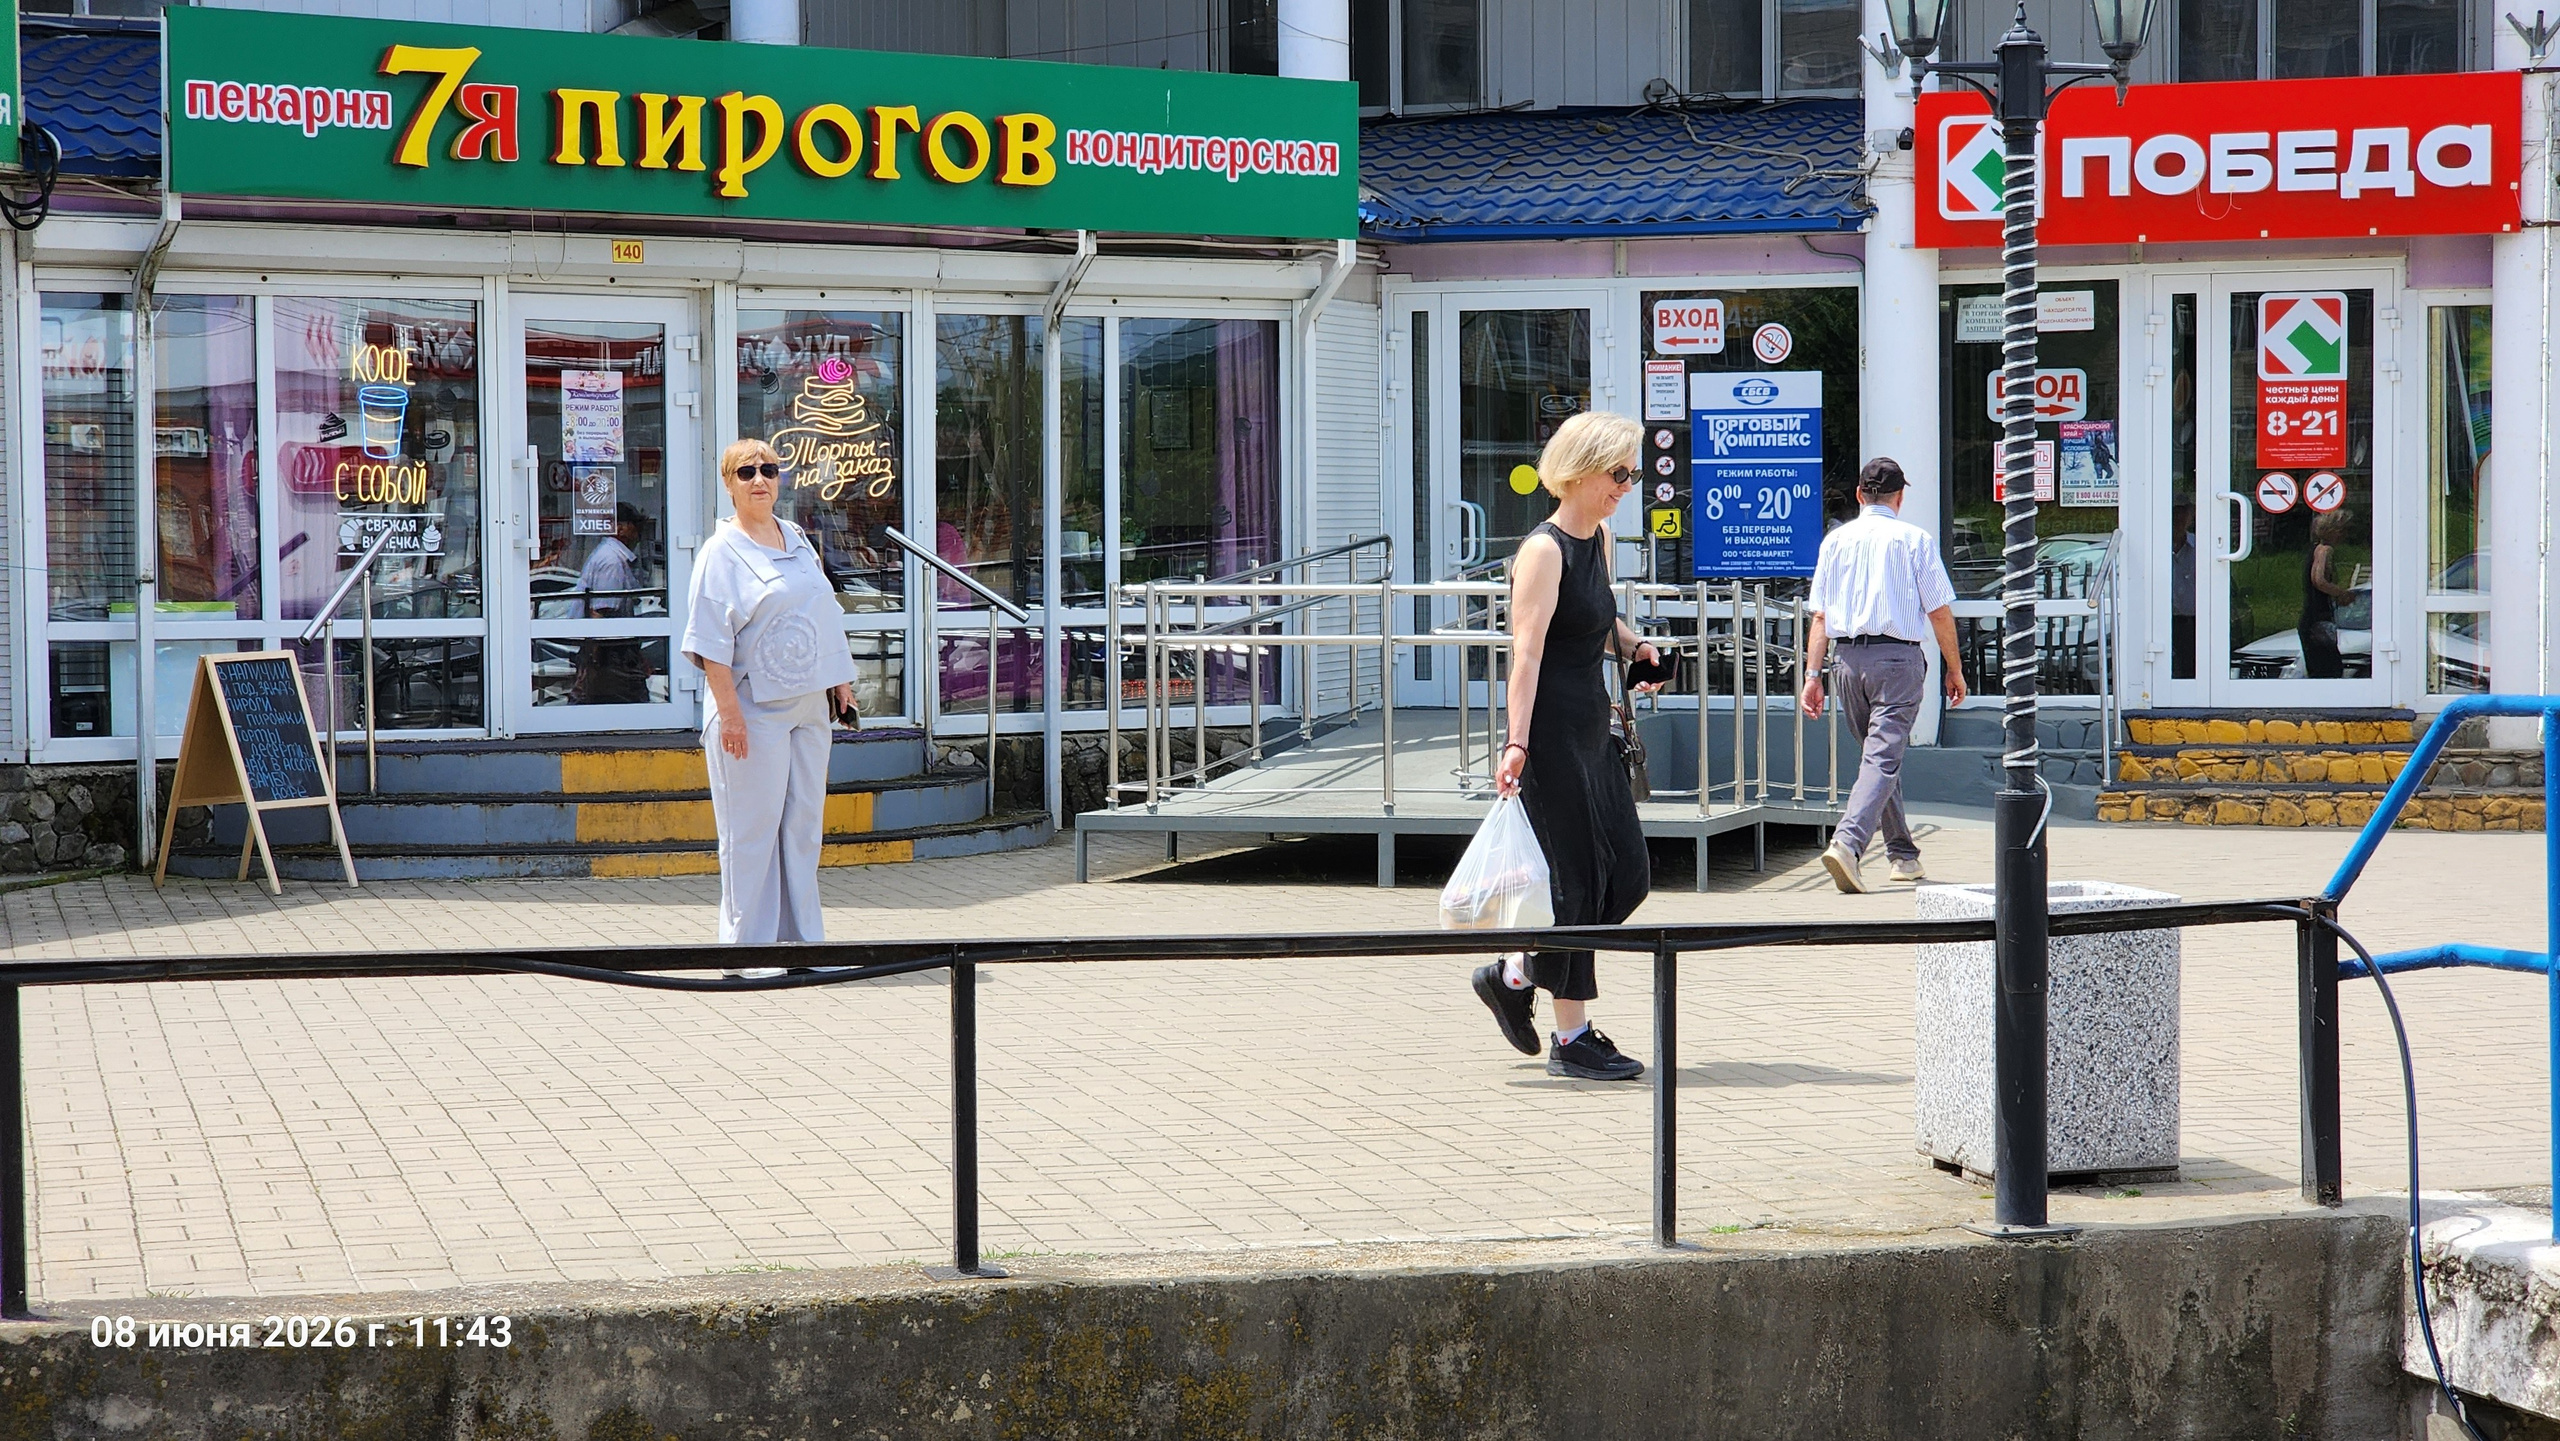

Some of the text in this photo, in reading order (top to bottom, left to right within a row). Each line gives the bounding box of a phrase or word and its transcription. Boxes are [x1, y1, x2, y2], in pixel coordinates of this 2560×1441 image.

[186, 79, 392, 137] пекарня
[549, 88, 1058, 198] пирогов
[1066, 128, 1340, 182] кондитерская
[2061, 124, 2492, 200] ПОБЕДА
[614, 244, 641, 259] 140
[1658, 308, 1720, 331] ВХОД
[351, 344, 418, 385] КОФЕ
[1741, 387, 1771, 396] СБСВ
[1996, 375, 2080, 402] ОД
[2311, 386, 2339, 394] цены
[2266, 394, 2339, 404] каждый день!
[565, 404, 620, 412] РЕЖИМ РАБОТЫ
[1702, 414, 1809, 441] ТОРГОВЫЙ
[2267, 410, 2337, 436] 8-21
[1714, 430, 1811, 455] КОМПЛЕКС
[779, 436, 877, 477] Торты
[795, 457, 896, 501] на заказ
[1717, 469, 1798, 478] РЕЖИМ РАБОТЫ:
[335, 461, 427, 505] С СОБОЙ
[579, 519, 612, 531] ХЛЕБ
[1722, 526, 1793, 534] БЕЗ ПЕРЕРЫВА
[362, 536, 421, 550] ВЕЧКА
[1725, 535, 1791, 546] И ВЫХОДНЫХ
[216, 661, 290, 681] В НАЛИЧИИ
[258, 681, 295, 696] ЗАКАЗ
[246, 711, 305, 727] ПИРОЖКИ
[272, 757, 280, 771] В
